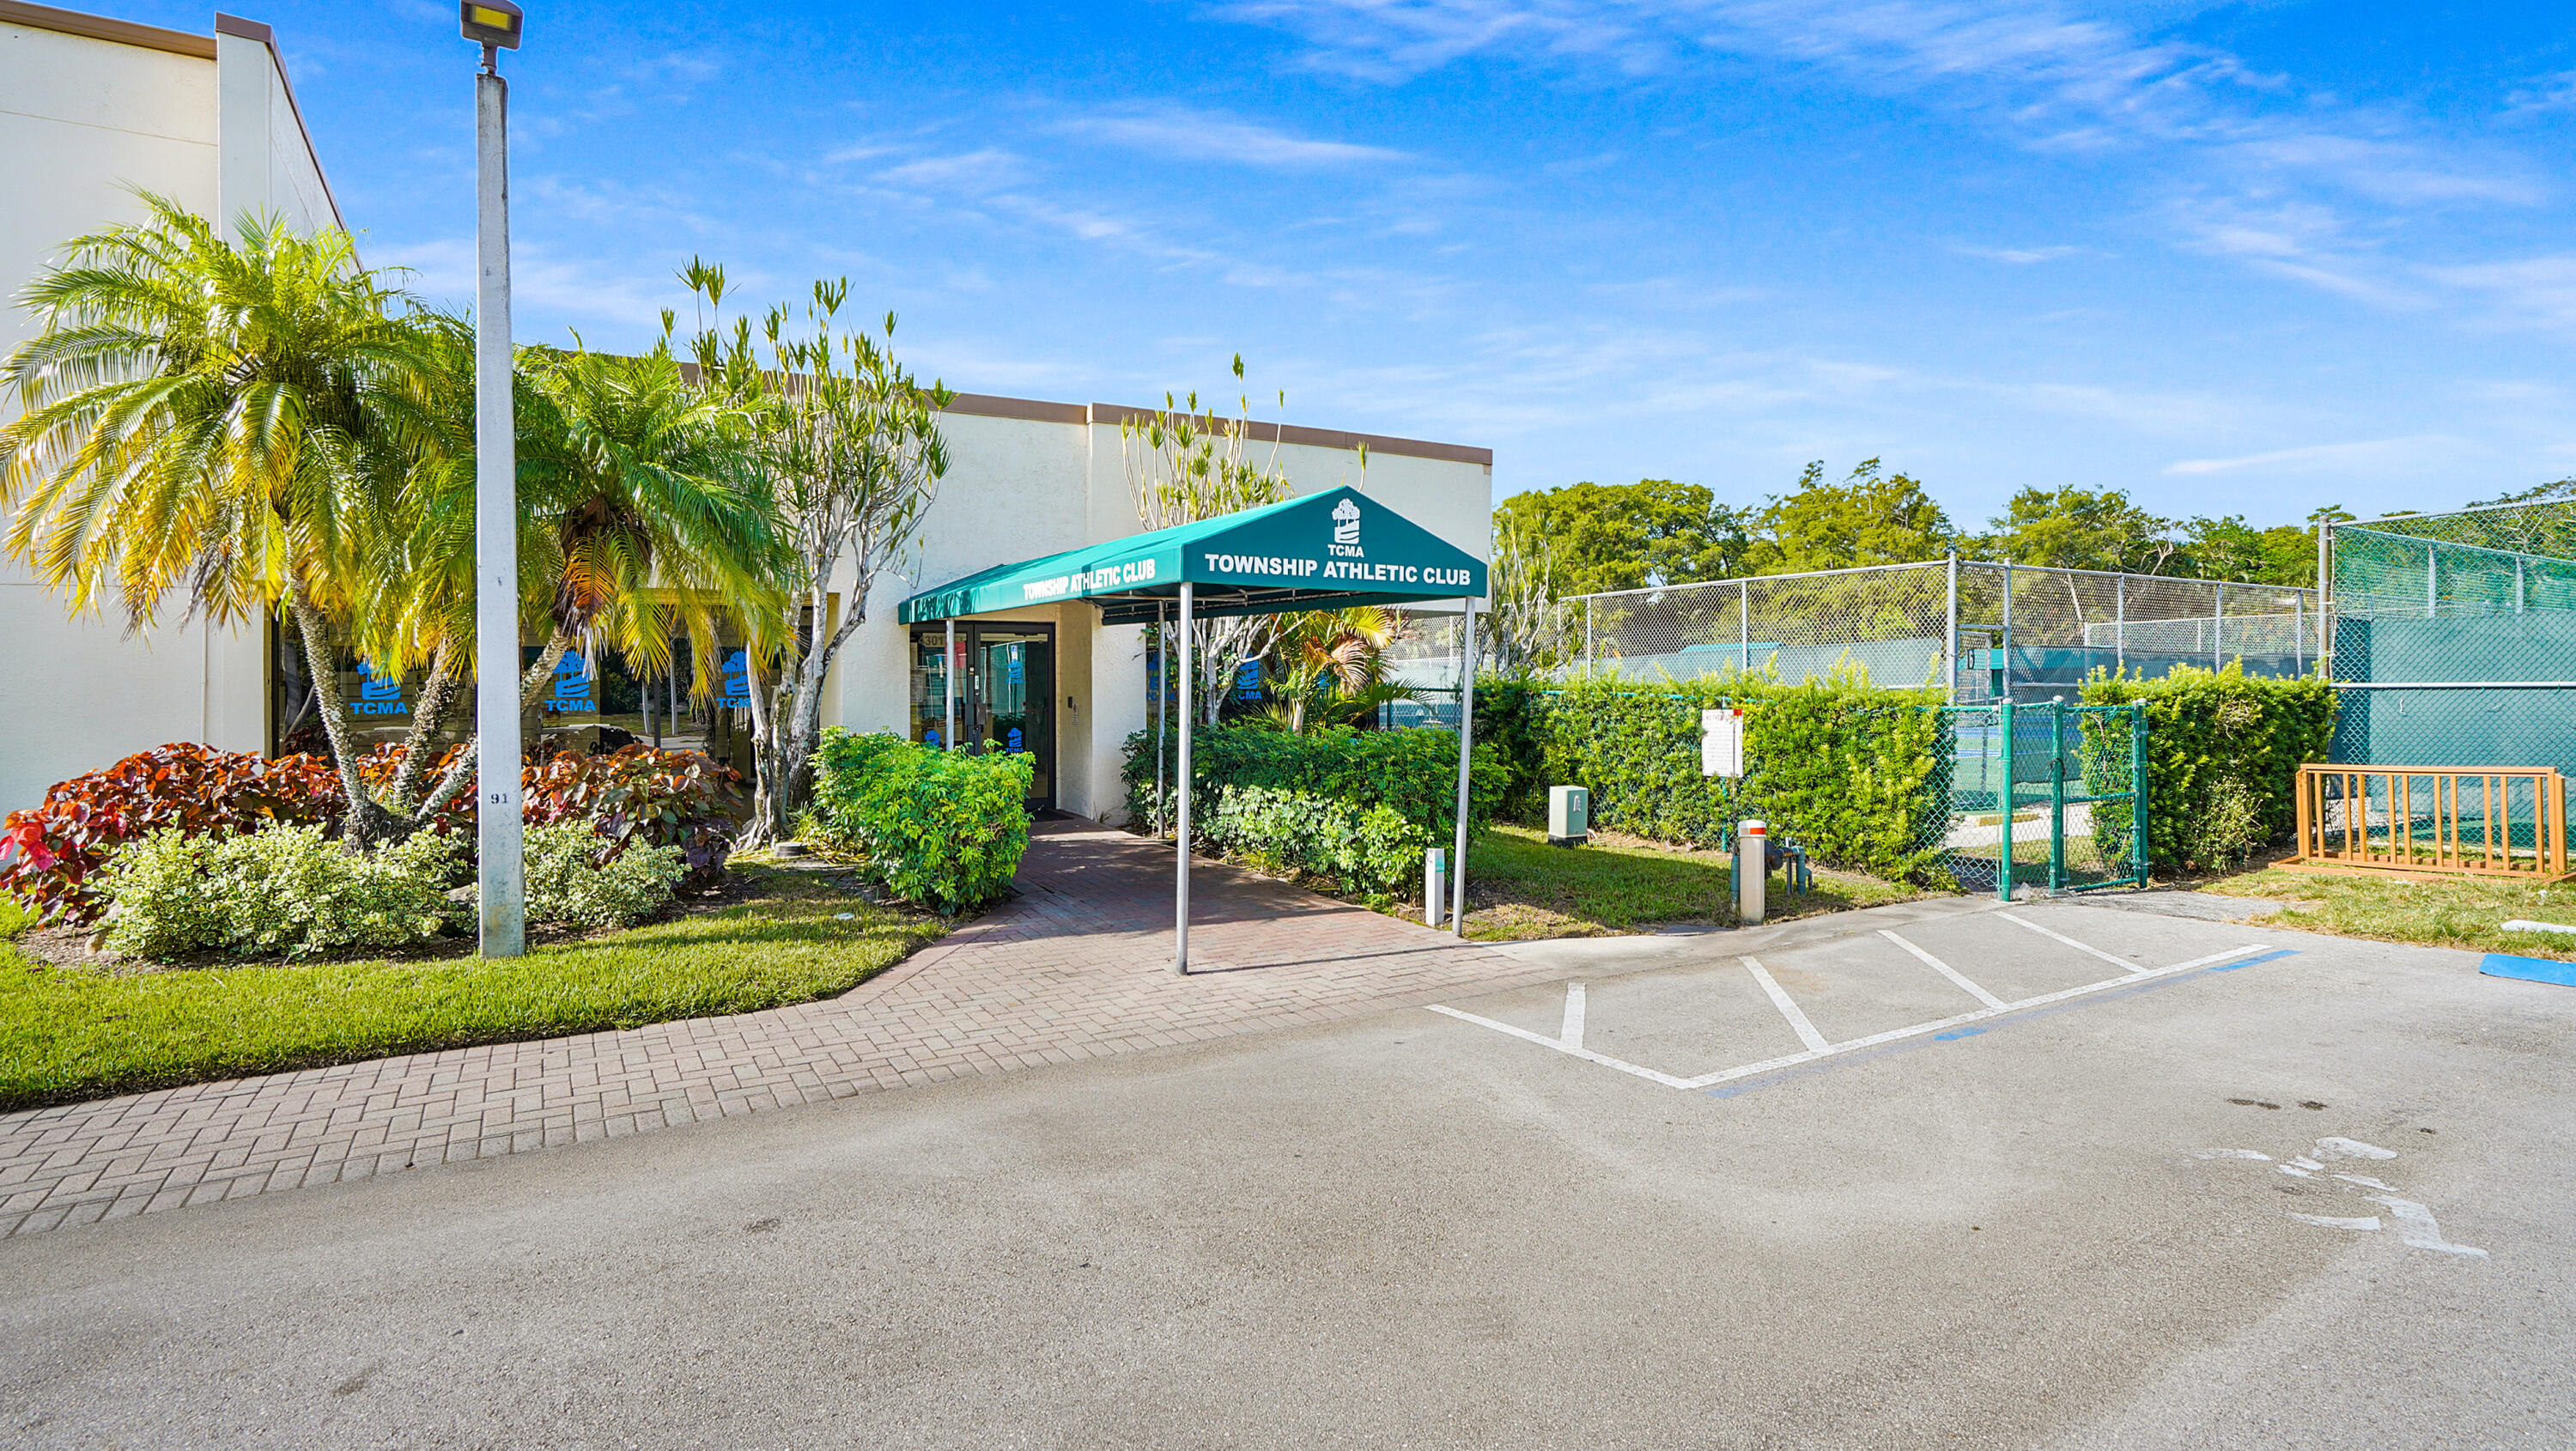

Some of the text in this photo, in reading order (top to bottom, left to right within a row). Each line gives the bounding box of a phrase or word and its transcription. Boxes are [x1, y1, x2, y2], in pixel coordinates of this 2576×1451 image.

[1327, 543, 1364, 557] TCMA
[1205, 554, 1471, 586] TOWNSHIP ATHLETIC CLUB
[1024, 558, 1156, 601] TOWNSHIP ATHLETIC CLUB
[349, 701, 409, 715] TCMA
[544, 699, 597, 712] TCMA
[716, 697, 751, 708] TCM
[490, 793, 508, 804] 91
